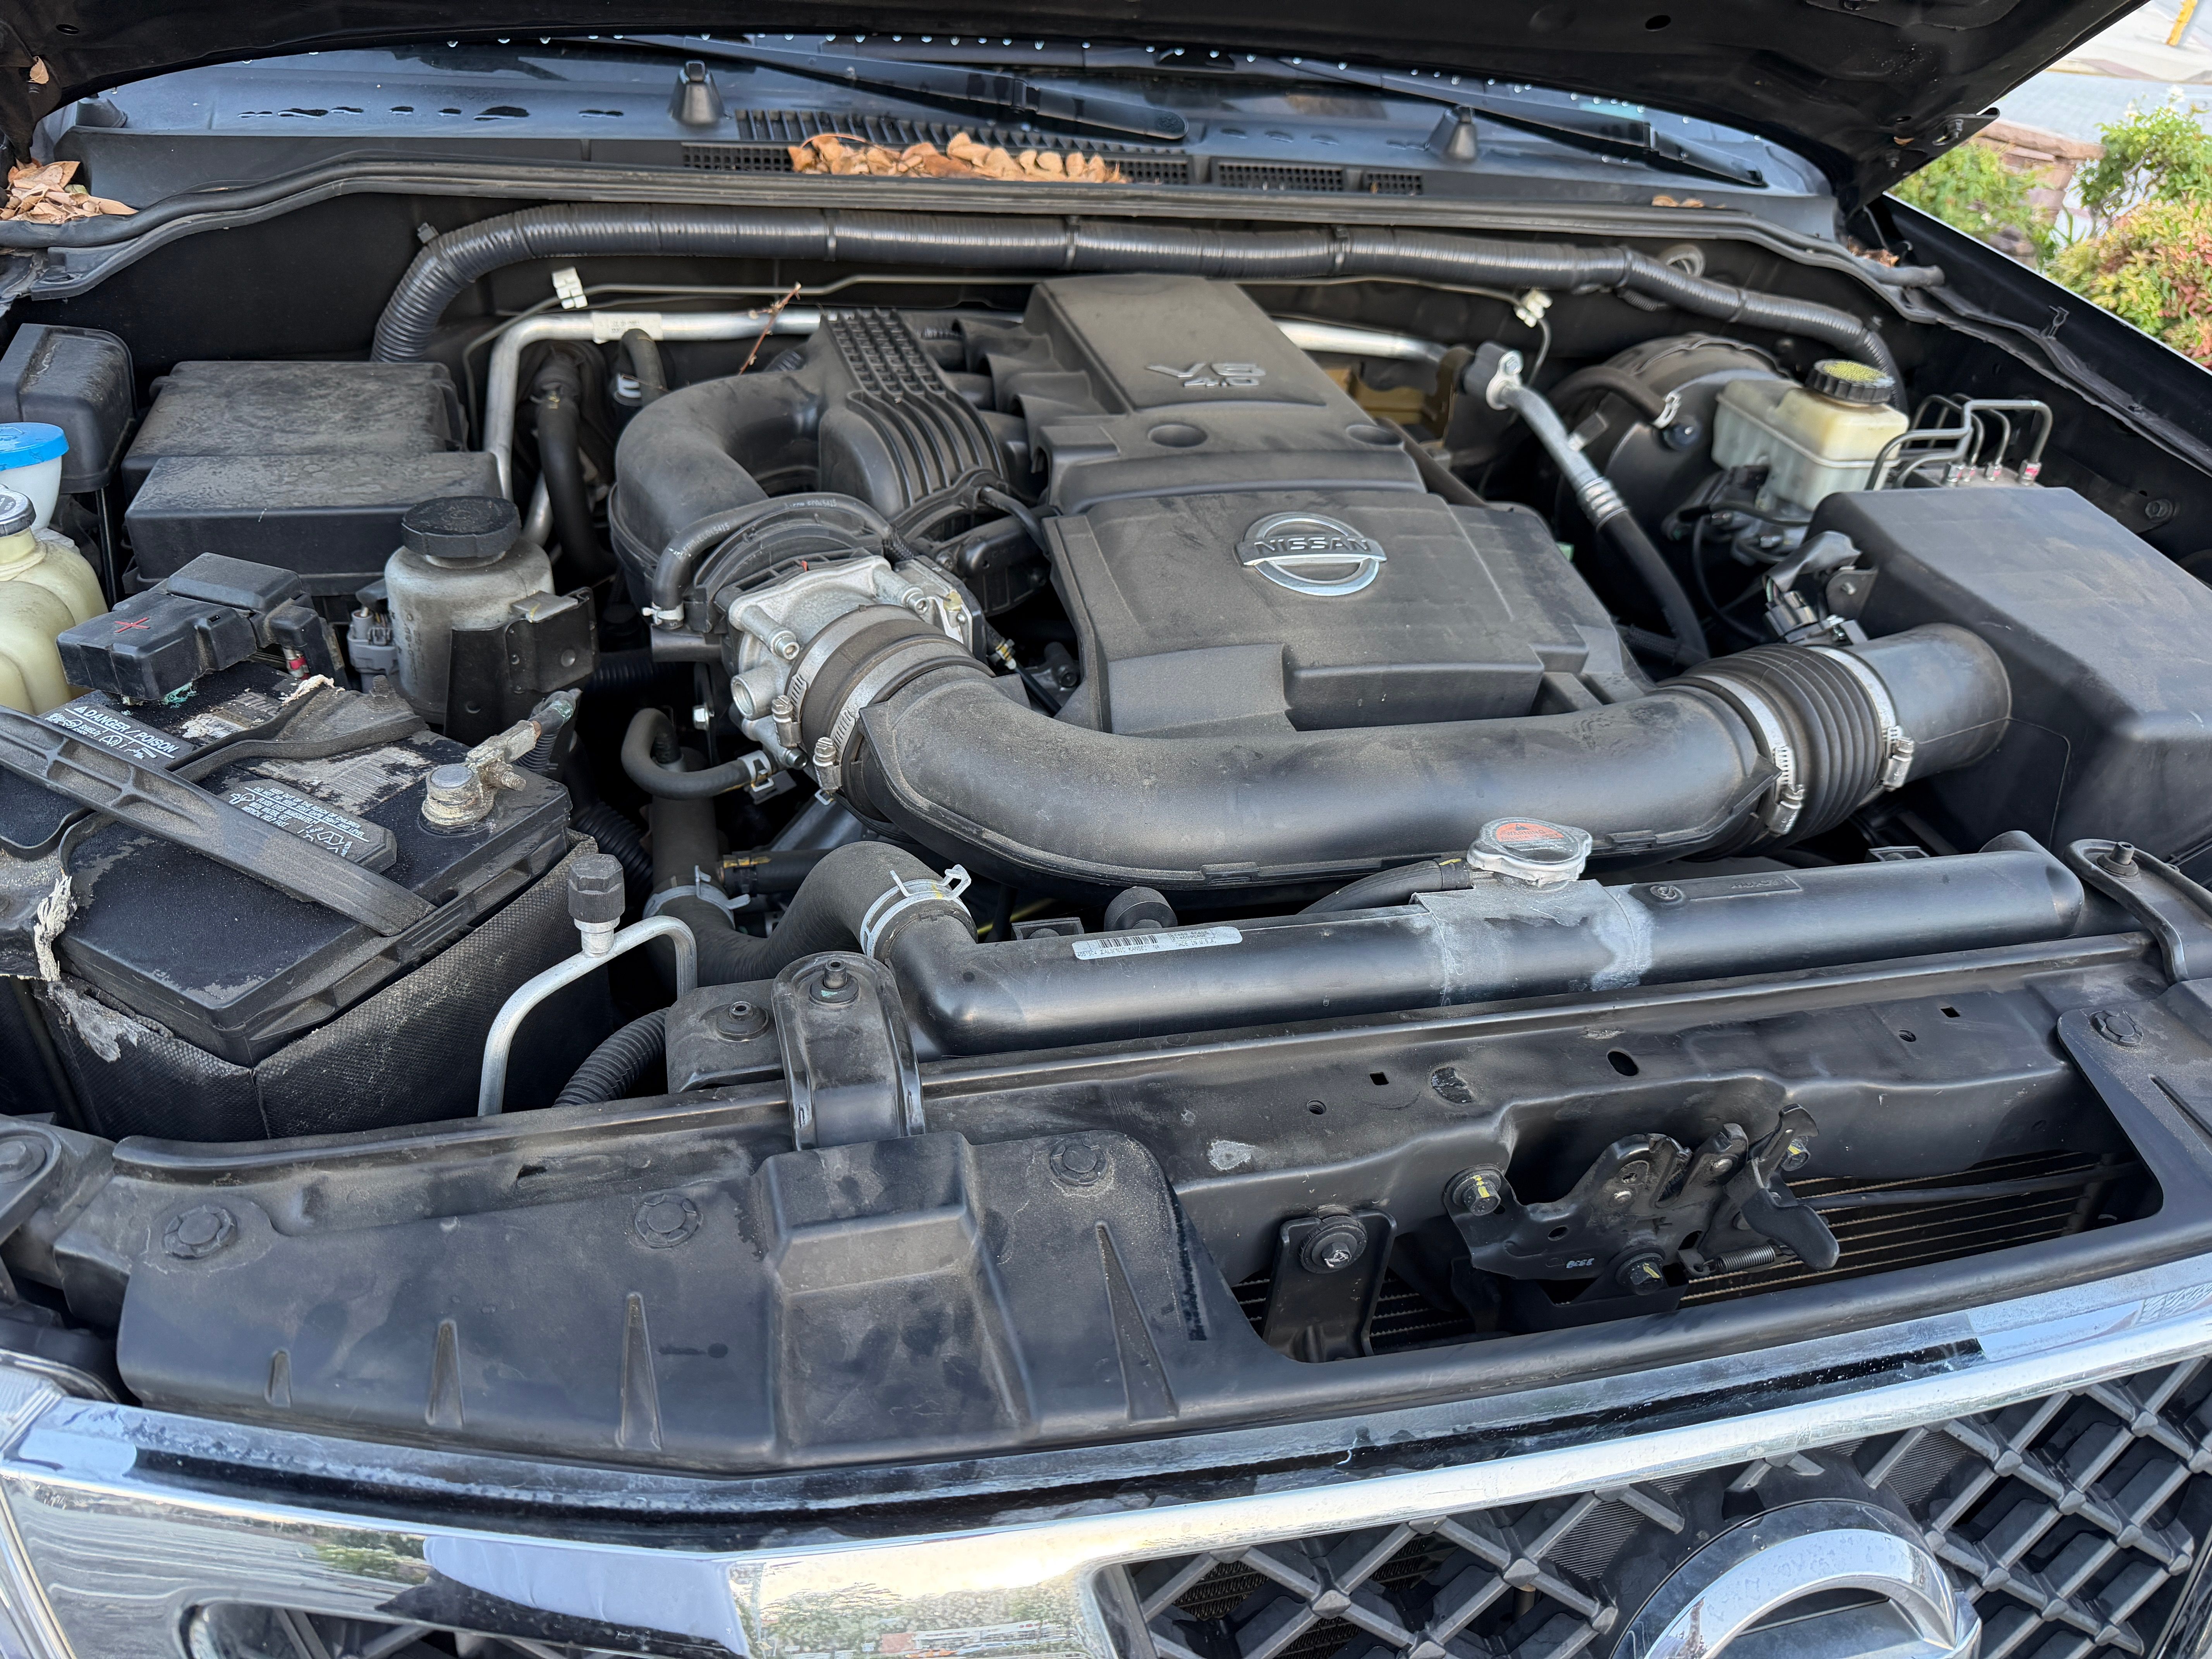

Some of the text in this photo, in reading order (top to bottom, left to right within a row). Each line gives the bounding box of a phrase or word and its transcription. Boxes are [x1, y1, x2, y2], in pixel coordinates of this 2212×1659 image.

[1146, 362, 1266, 378] V6
[1183, 377, 1259, 388] 4.0
[1254, 537, 1371, 552] NISSAN
[83, 708, 131, 732] DANGER
[134, 731, 179, 753] POISON
[241, 805, 289, 827] MEDICAL HELP FAST
[249, 801, 263, 810] WITH
[256, 797, 315, 824] FLUSH EYES IMMEDIATELY
[269, 787, 284, 796] KEEP
[311, 805, 330, 815] REACH
[335, 815, 362, 829] CHILDREN
[282, 799, 297, 807] KEEP
[309, 810, 324, 819] CAPS
[322, 816, 339, 824] TIGHT
[348, 828, 365, 837] LEVEL
